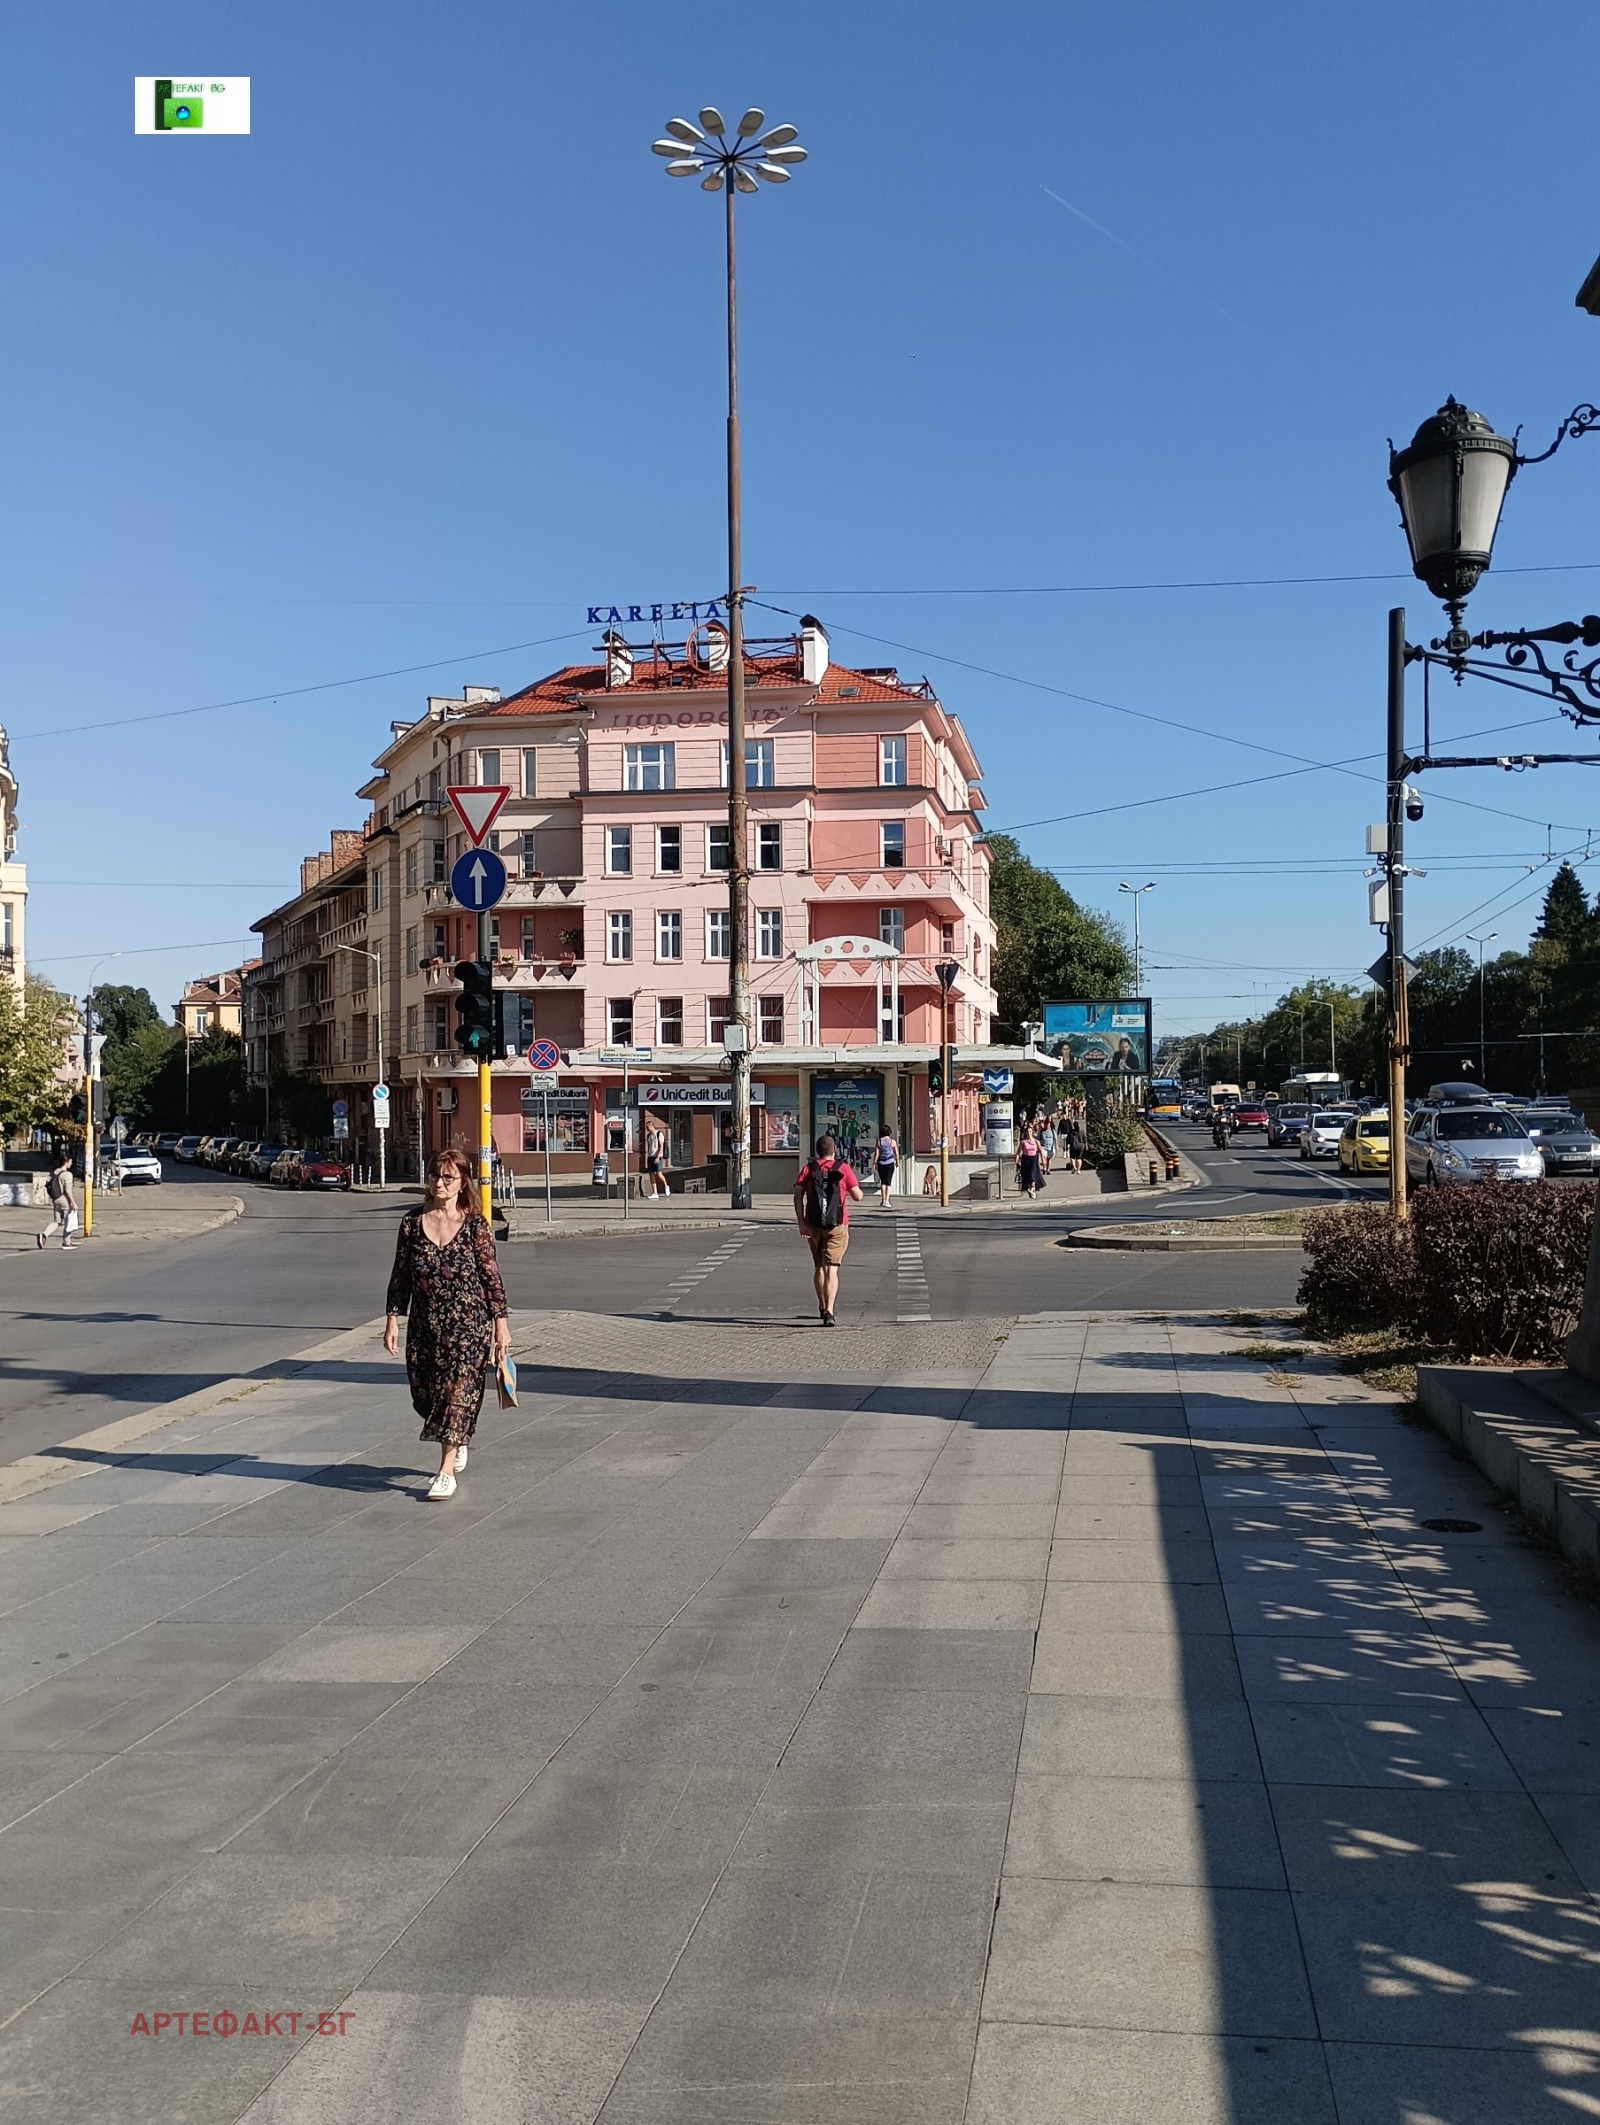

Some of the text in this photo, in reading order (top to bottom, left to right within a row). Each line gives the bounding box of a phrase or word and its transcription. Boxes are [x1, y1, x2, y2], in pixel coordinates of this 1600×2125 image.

[587, 602, 722, 624] KARELIA
[560, 1089, 588, 1098] Bulbank
[661, 1088, 756, 1101] UniCredit Bulk
